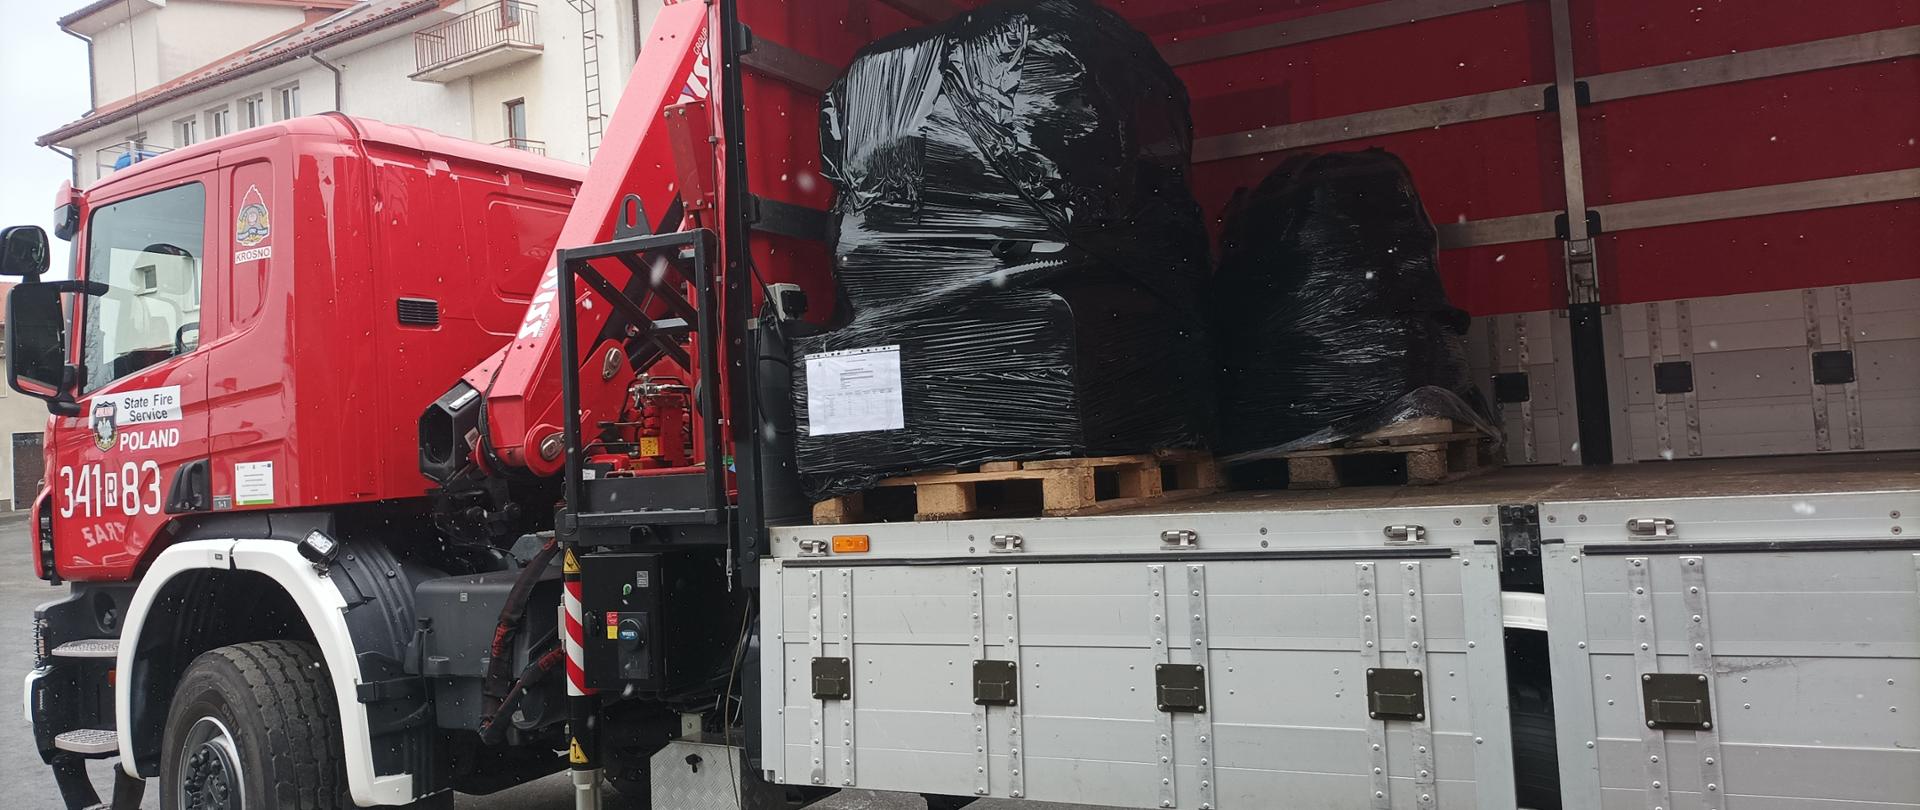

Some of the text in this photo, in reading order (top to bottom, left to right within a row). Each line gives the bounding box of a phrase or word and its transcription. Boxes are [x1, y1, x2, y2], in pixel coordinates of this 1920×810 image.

[236, 248, 270, 263] KROSNO
[123, 394, 173, 410] State Fire
[129, 408, 168, 422] Service
[119, 428, 180, 452] POLAND
[60, 460, 161, 518] 341 R 83
